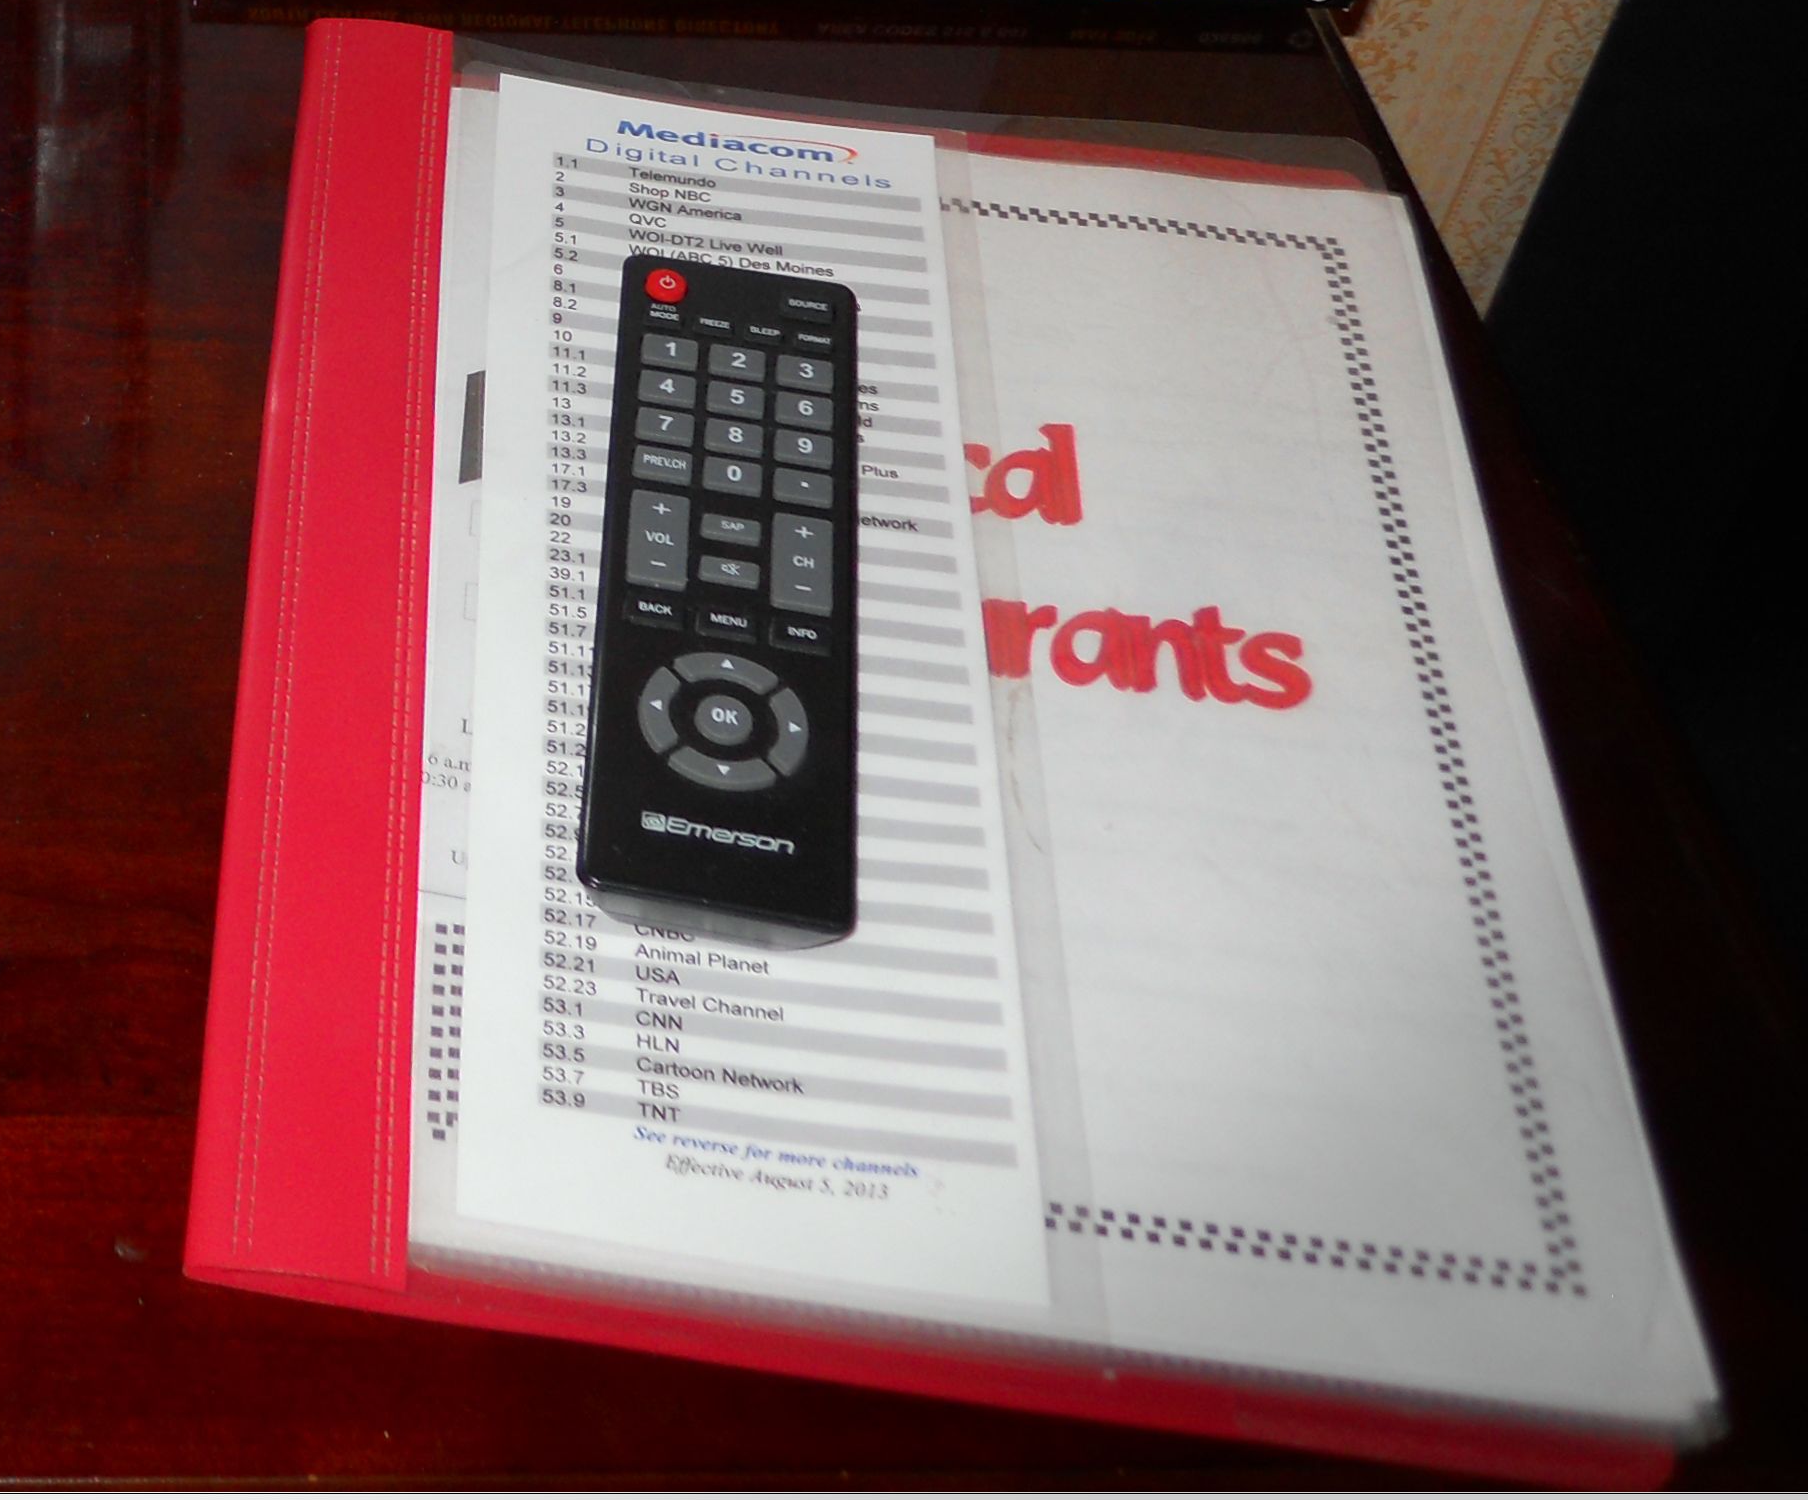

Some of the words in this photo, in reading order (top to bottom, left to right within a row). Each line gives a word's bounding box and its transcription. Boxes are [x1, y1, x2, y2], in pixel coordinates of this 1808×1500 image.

[617, 120, 836, 162] Mediacom
[586, 137, 700, 168] Digital
[715, 158, 893, 190] Channels
[629, 167, 717, 189] Telemundo
[629, 183, 670, 200] Shop
[673, 189, 712, 203] NBC
[629, 198, 673, 213] WGN
[677, 204, 743, 222] America
[629, 213, 668, 229] QVC
[860, 463, 900, 480] Plus
[856, 514, 920, 533] etwork
[644, 530, 675, 547] VOL
[793, 554, 815, 570] CH
[638, 601, 673, 617] BACK
[709, 613, 748, 629] MENU
[787, 626, 818, 641] INFO
[711, 705, 739, 727] OK
[666, 816, 795, 856] Emerson
[633, 942, 701, 968] Animal
[707, 951, 769, 975] Planet
[634, 964, 681, 986] USA
[634, 986, 696, 1013] Travel
[701, 995, 784, 1021] Channel
[634, 1009, 683, 1031] CNN
[635, 1032, 680, 1054] HLN
[635, 1055, 715, 1082] Cartoon
[721, 1066, 804, 1094] Network
[636, 1078, 680, 1100] TBS
[637, 1101, 680, 1123] TNT
[634, 1126, 666, 1143] See
[672, 1135, 739, 1155] reverse
[743, 1143, 772, 1162] for
[777, 1152, 827, 1169] more
[831, 1156, 918, 1177] channels
[665, 1153, 744, 1180] Effective
[749, 1168, 813, 1191] August
[843, 1179, 888, 1199] 2013
